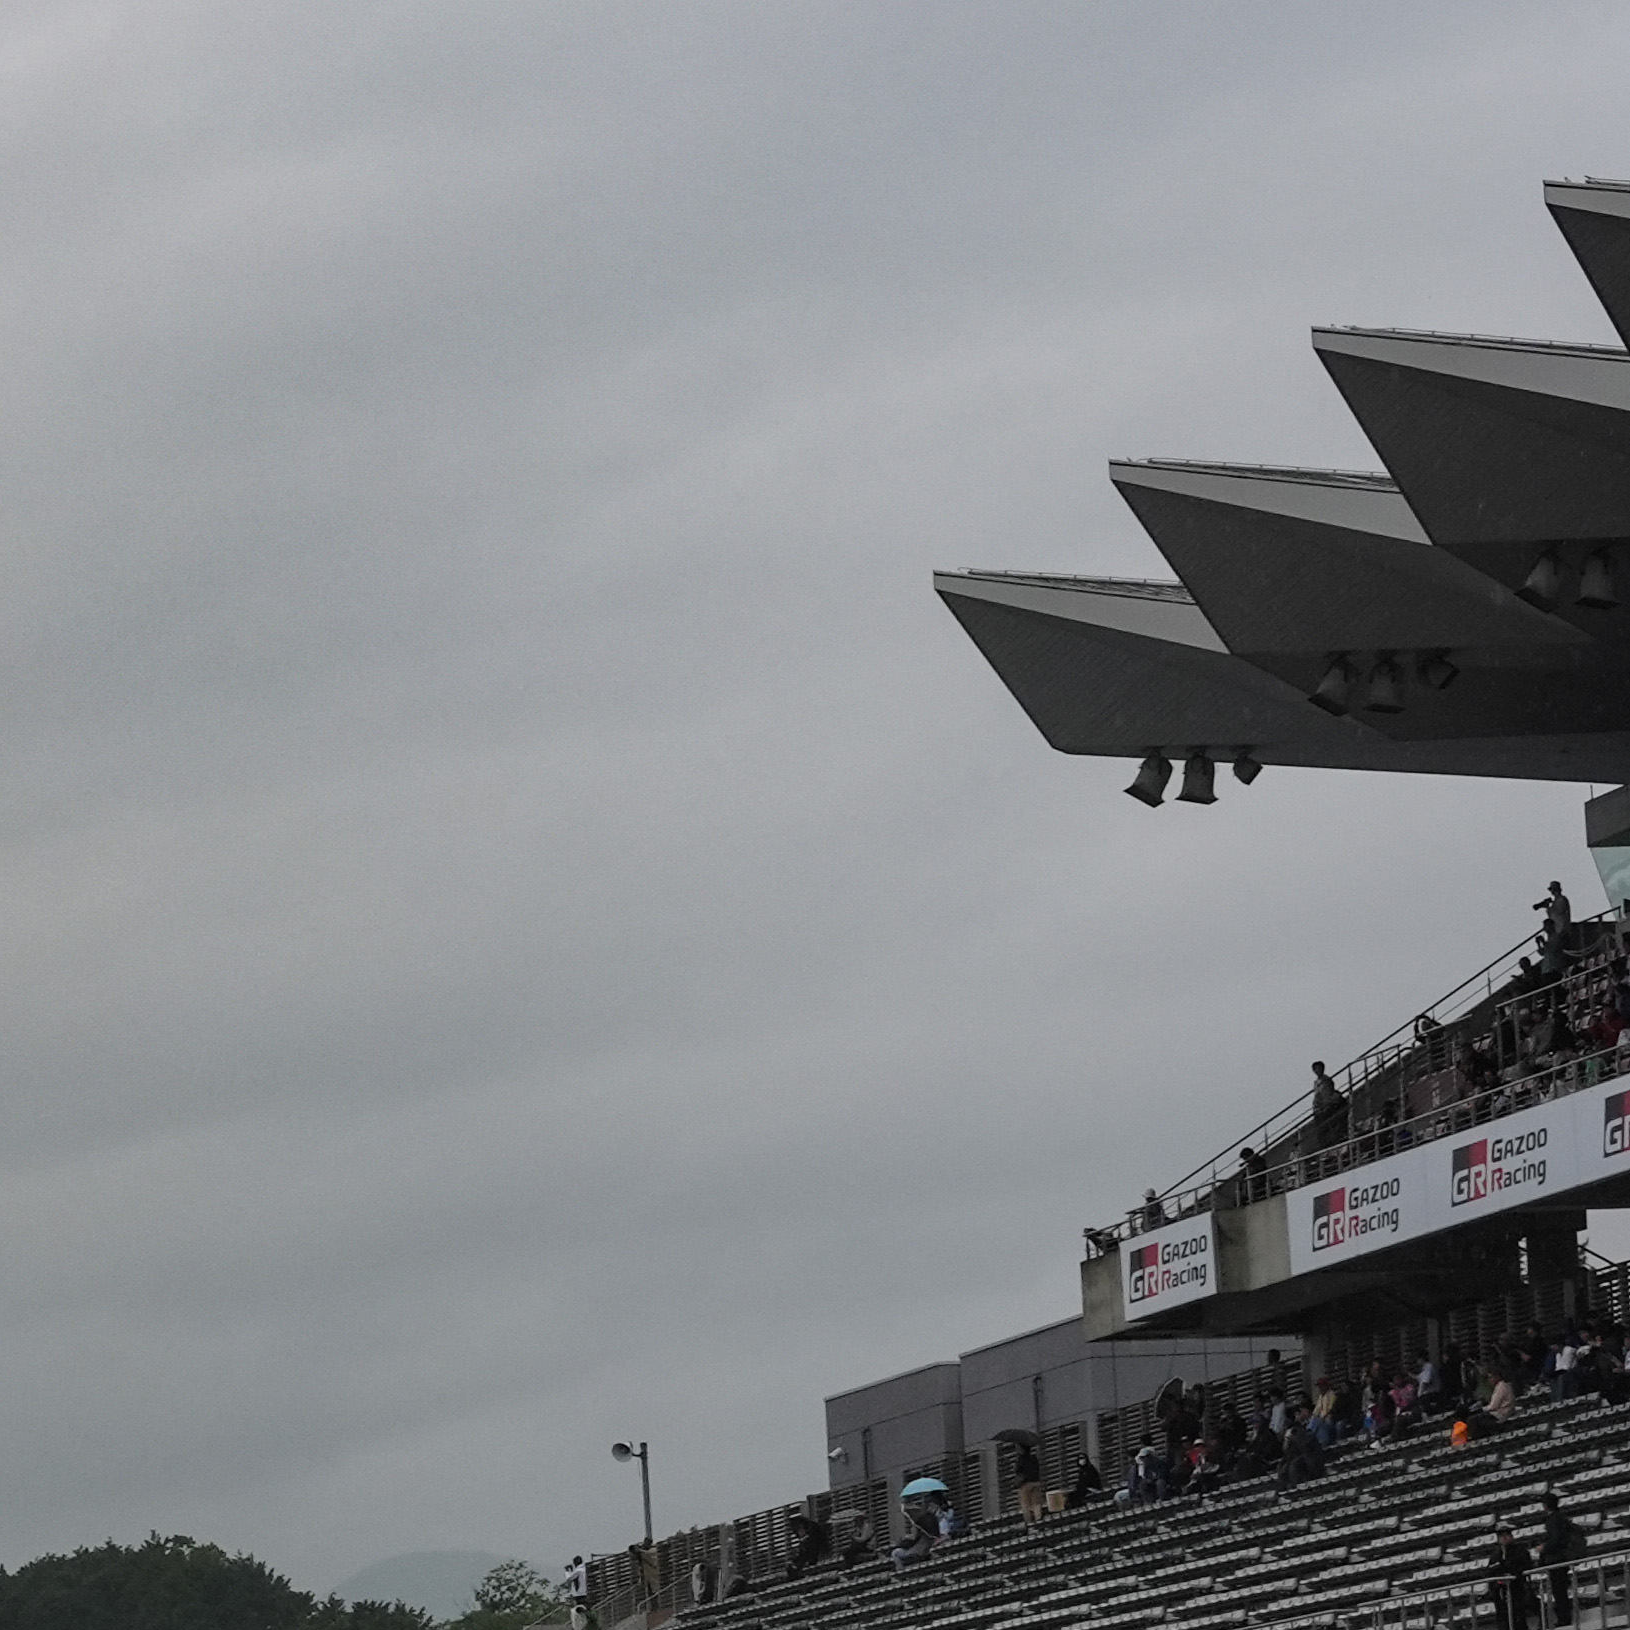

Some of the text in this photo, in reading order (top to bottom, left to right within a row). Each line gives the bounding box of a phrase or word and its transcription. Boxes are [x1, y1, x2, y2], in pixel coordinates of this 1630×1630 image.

[1491, 1127, 1548, 1163] GAZOO
[1452, 1162, 1486, 1204] GR
[1491, 1158, 1547, 1193] Racing
[1349, 1177, 1400, 1210] GAZOO
[1313, 1210, 1345, 1250] GR
[1348, 1207, 1399, 1238] Racing
[1161, 1234, 1208, 1265] GAZOO
[1130, 1264, 1159, 1301] GR
[1161, 1262, 1207, 1292] Racing
